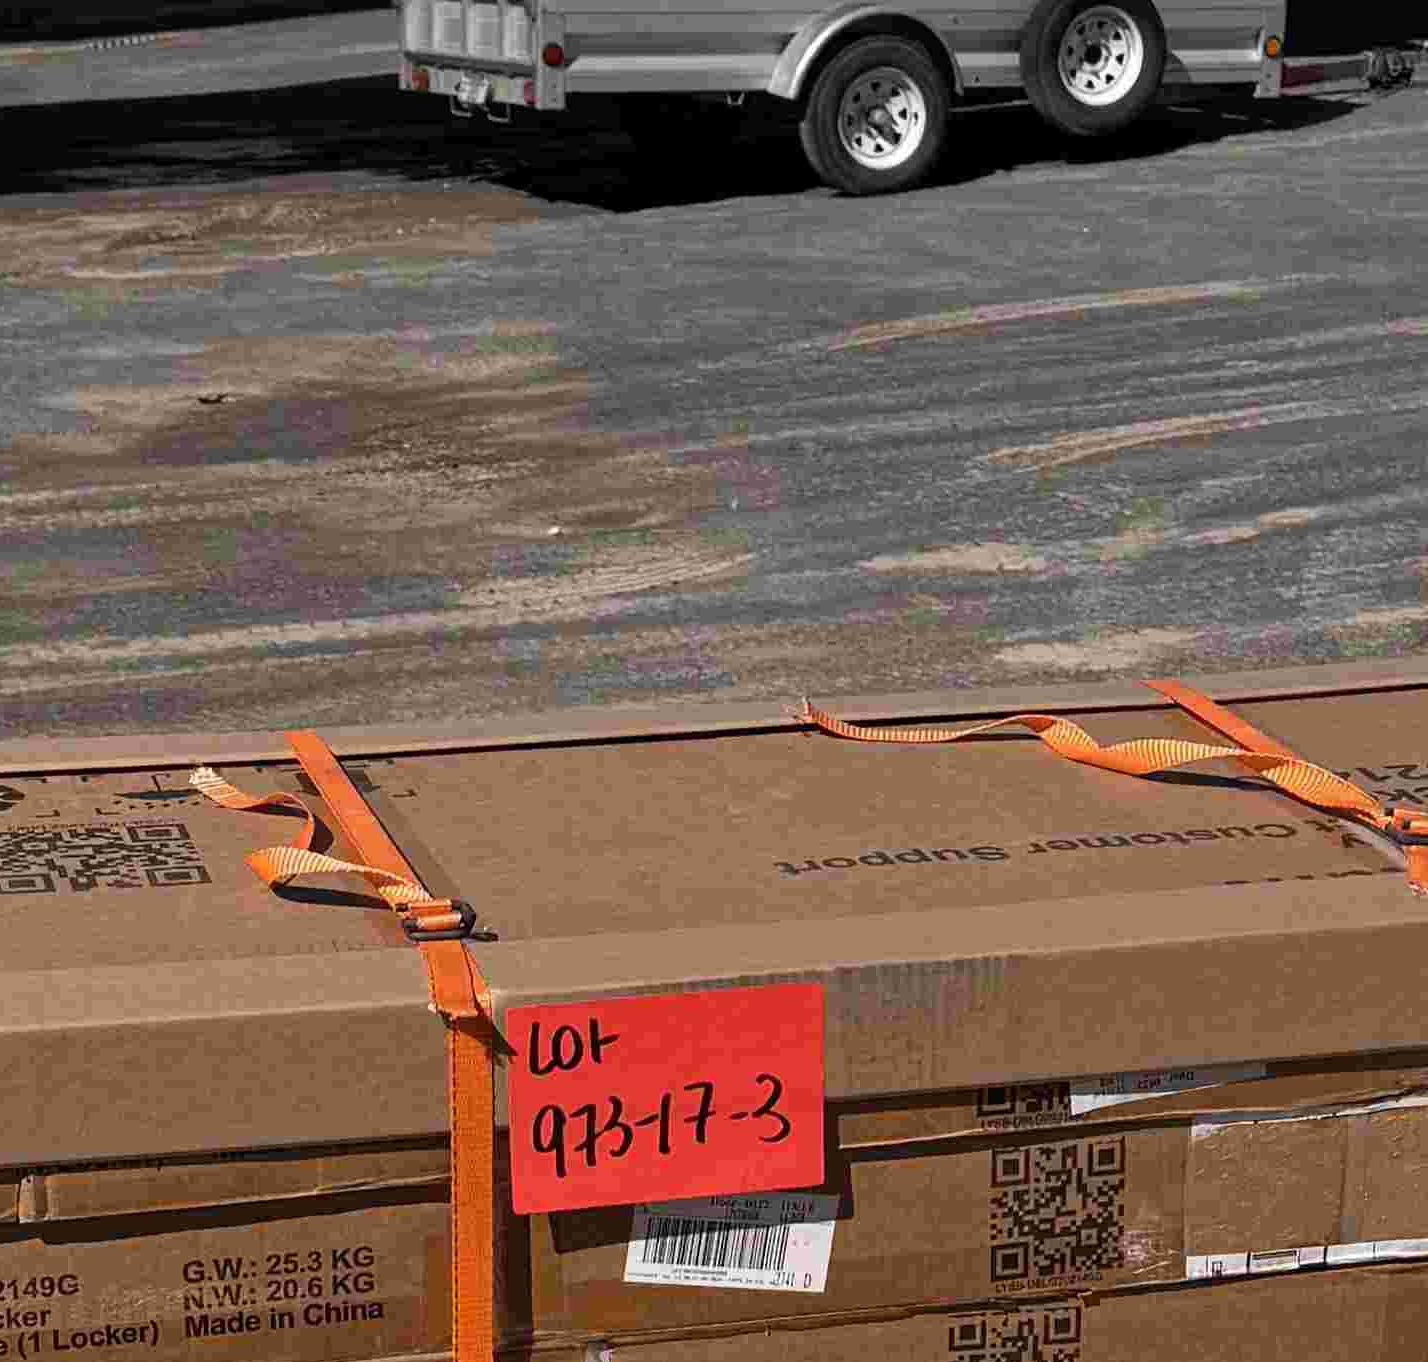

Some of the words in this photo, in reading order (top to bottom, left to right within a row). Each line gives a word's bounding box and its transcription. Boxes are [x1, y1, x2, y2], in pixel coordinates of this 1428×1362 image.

[1028, 823, 1294, 854] Customer
[772, 844, 1011, 878] Support
[532, 1073, 791, 1178] 973-17-3
[183, 1257, 257, 1283] G.W.:
[265, 1250, 323, 1275] 25.3
[332, 1246, 375, 1270] KG
[183, 1283, 257, 1311] N.W.:
[265, 1276, 323, 1303] 20.6
[332, 1272, 375, 1296] KG
[185, 1311, 261, 1338] Made
[269, 1307, 294, 1330] in
[303, 1301, 384, 1326] China
[18, 1331, 41, 1361] (1
[53, 1320, 160, 1351] Locker)
